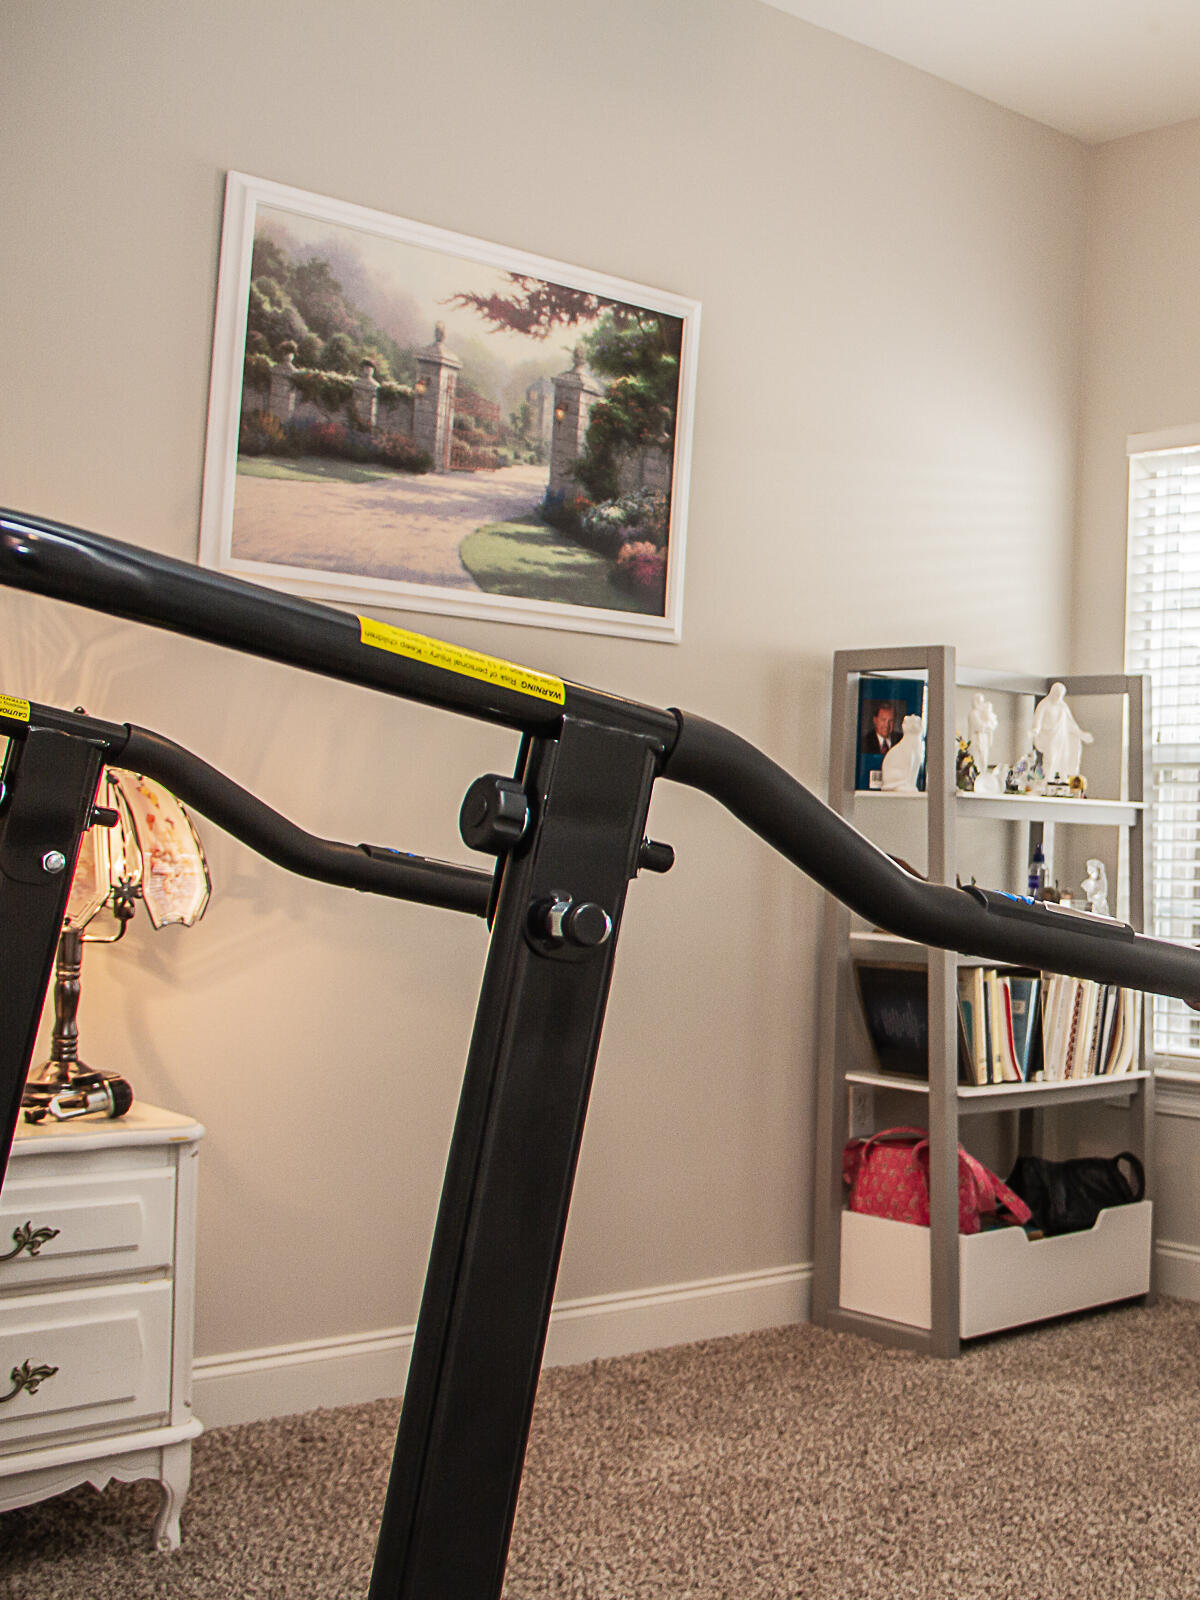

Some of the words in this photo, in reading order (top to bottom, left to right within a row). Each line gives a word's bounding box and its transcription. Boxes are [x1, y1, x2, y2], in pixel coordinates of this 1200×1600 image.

[364, 631, 397, 646] children
[399, 642, 422, 655] Keep
[429, 650, 452, 662] injury
[453, 658, 488, 674] personal
[489, 671, 498, 679] of
[500, 674, 517, 685] Risk
[520, 680, 562, 699] WARNING
